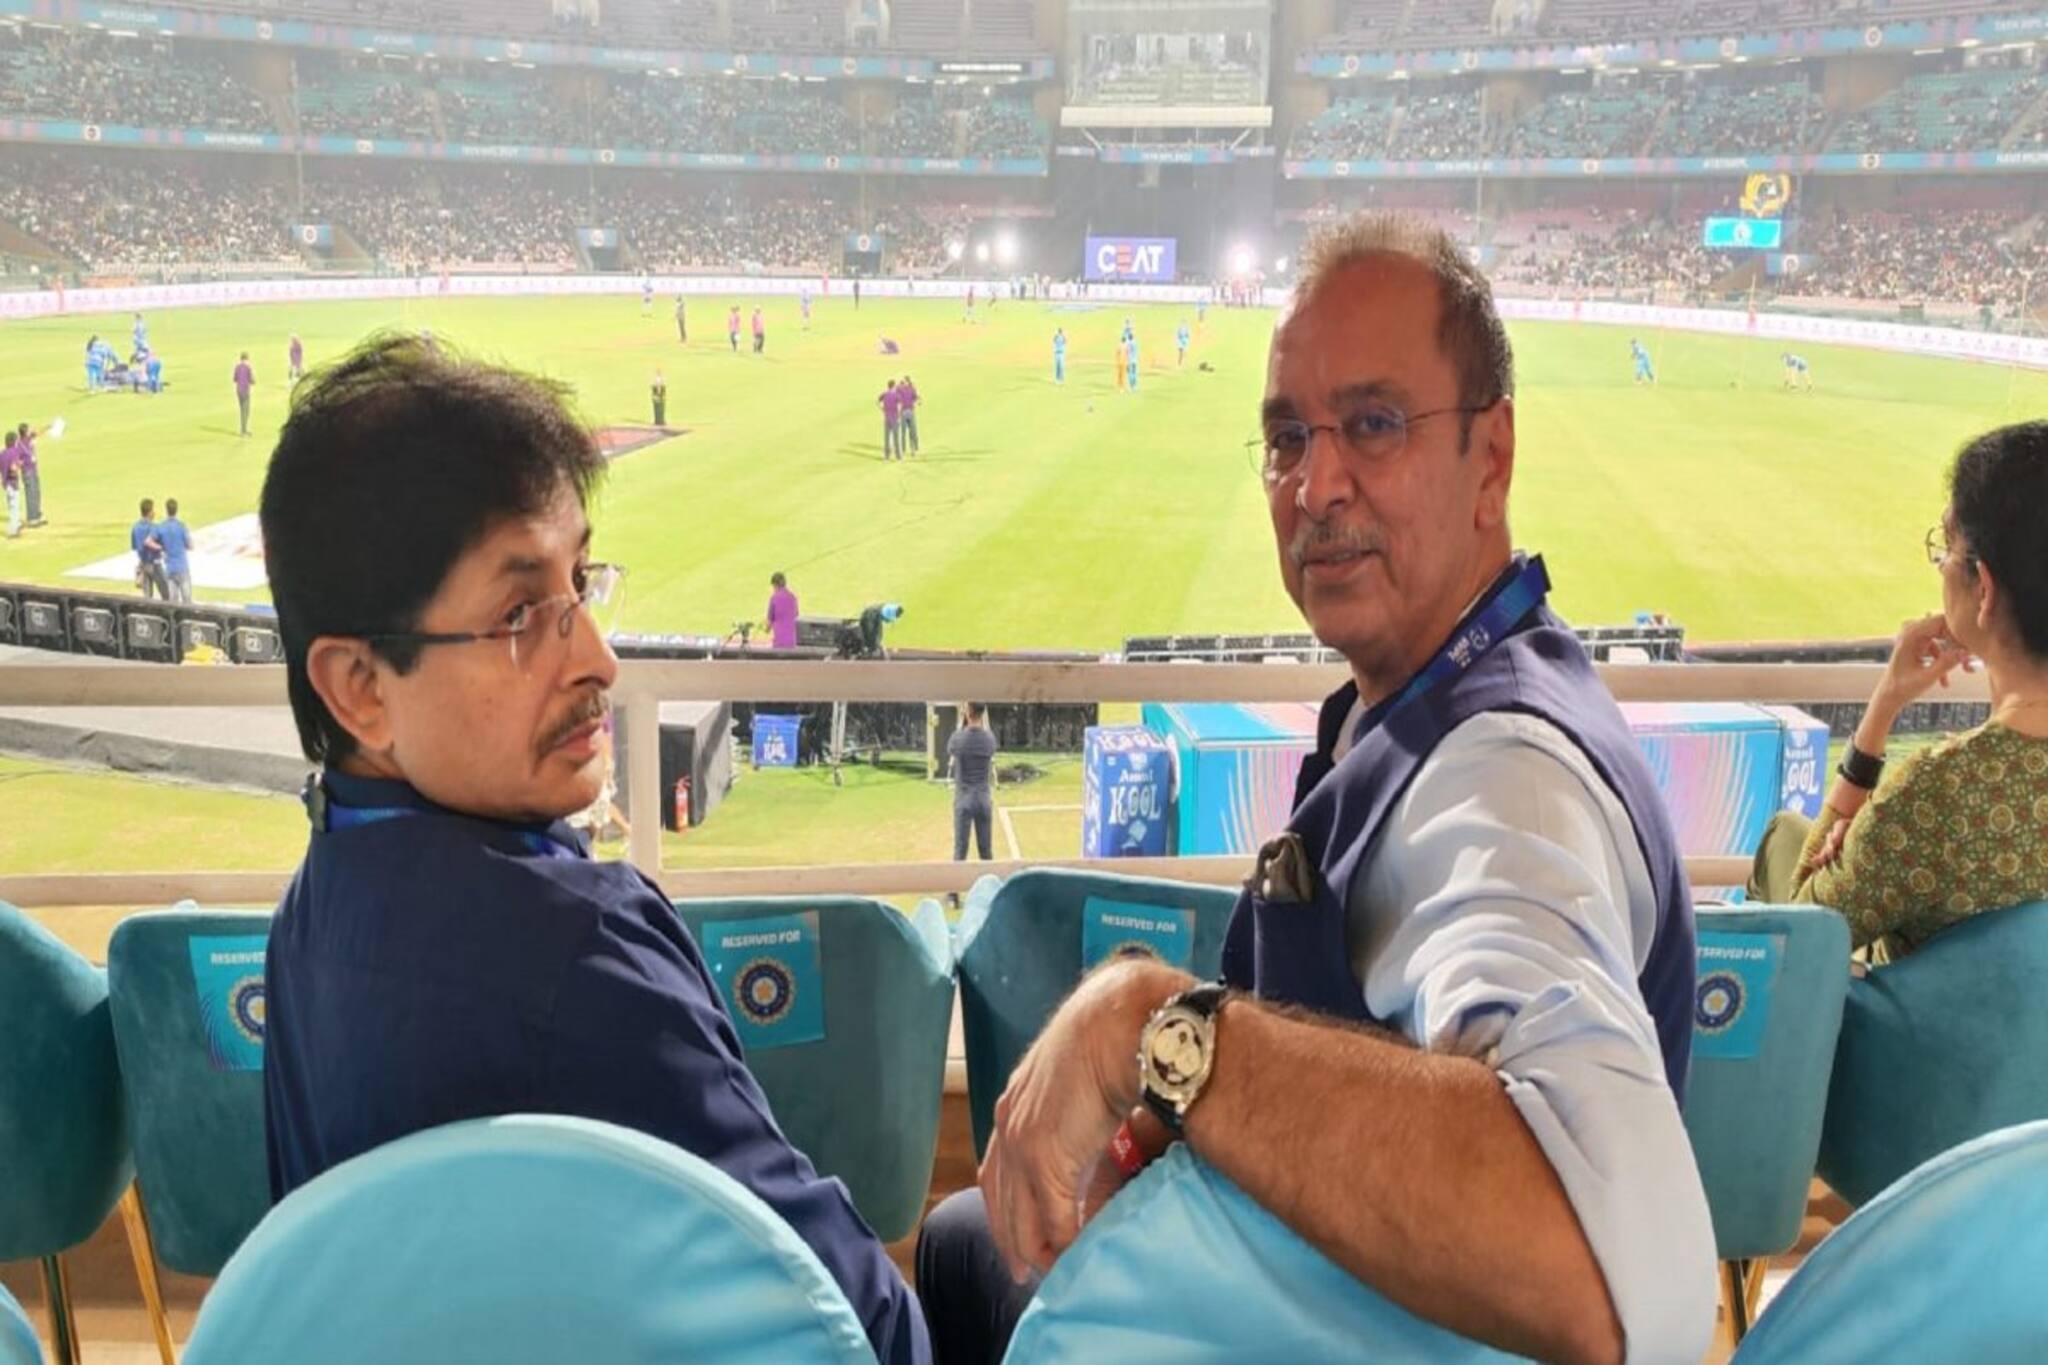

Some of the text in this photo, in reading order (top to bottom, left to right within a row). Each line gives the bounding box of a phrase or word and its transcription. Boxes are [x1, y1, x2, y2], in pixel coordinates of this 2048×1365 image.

[1098, 244, 1164, 274] CEAT
[1782, 760, 1820, 799] OOL
[1108, 784, 1161, 825] KOOL
[721, 930, 801, 948] RESERVED FOR
